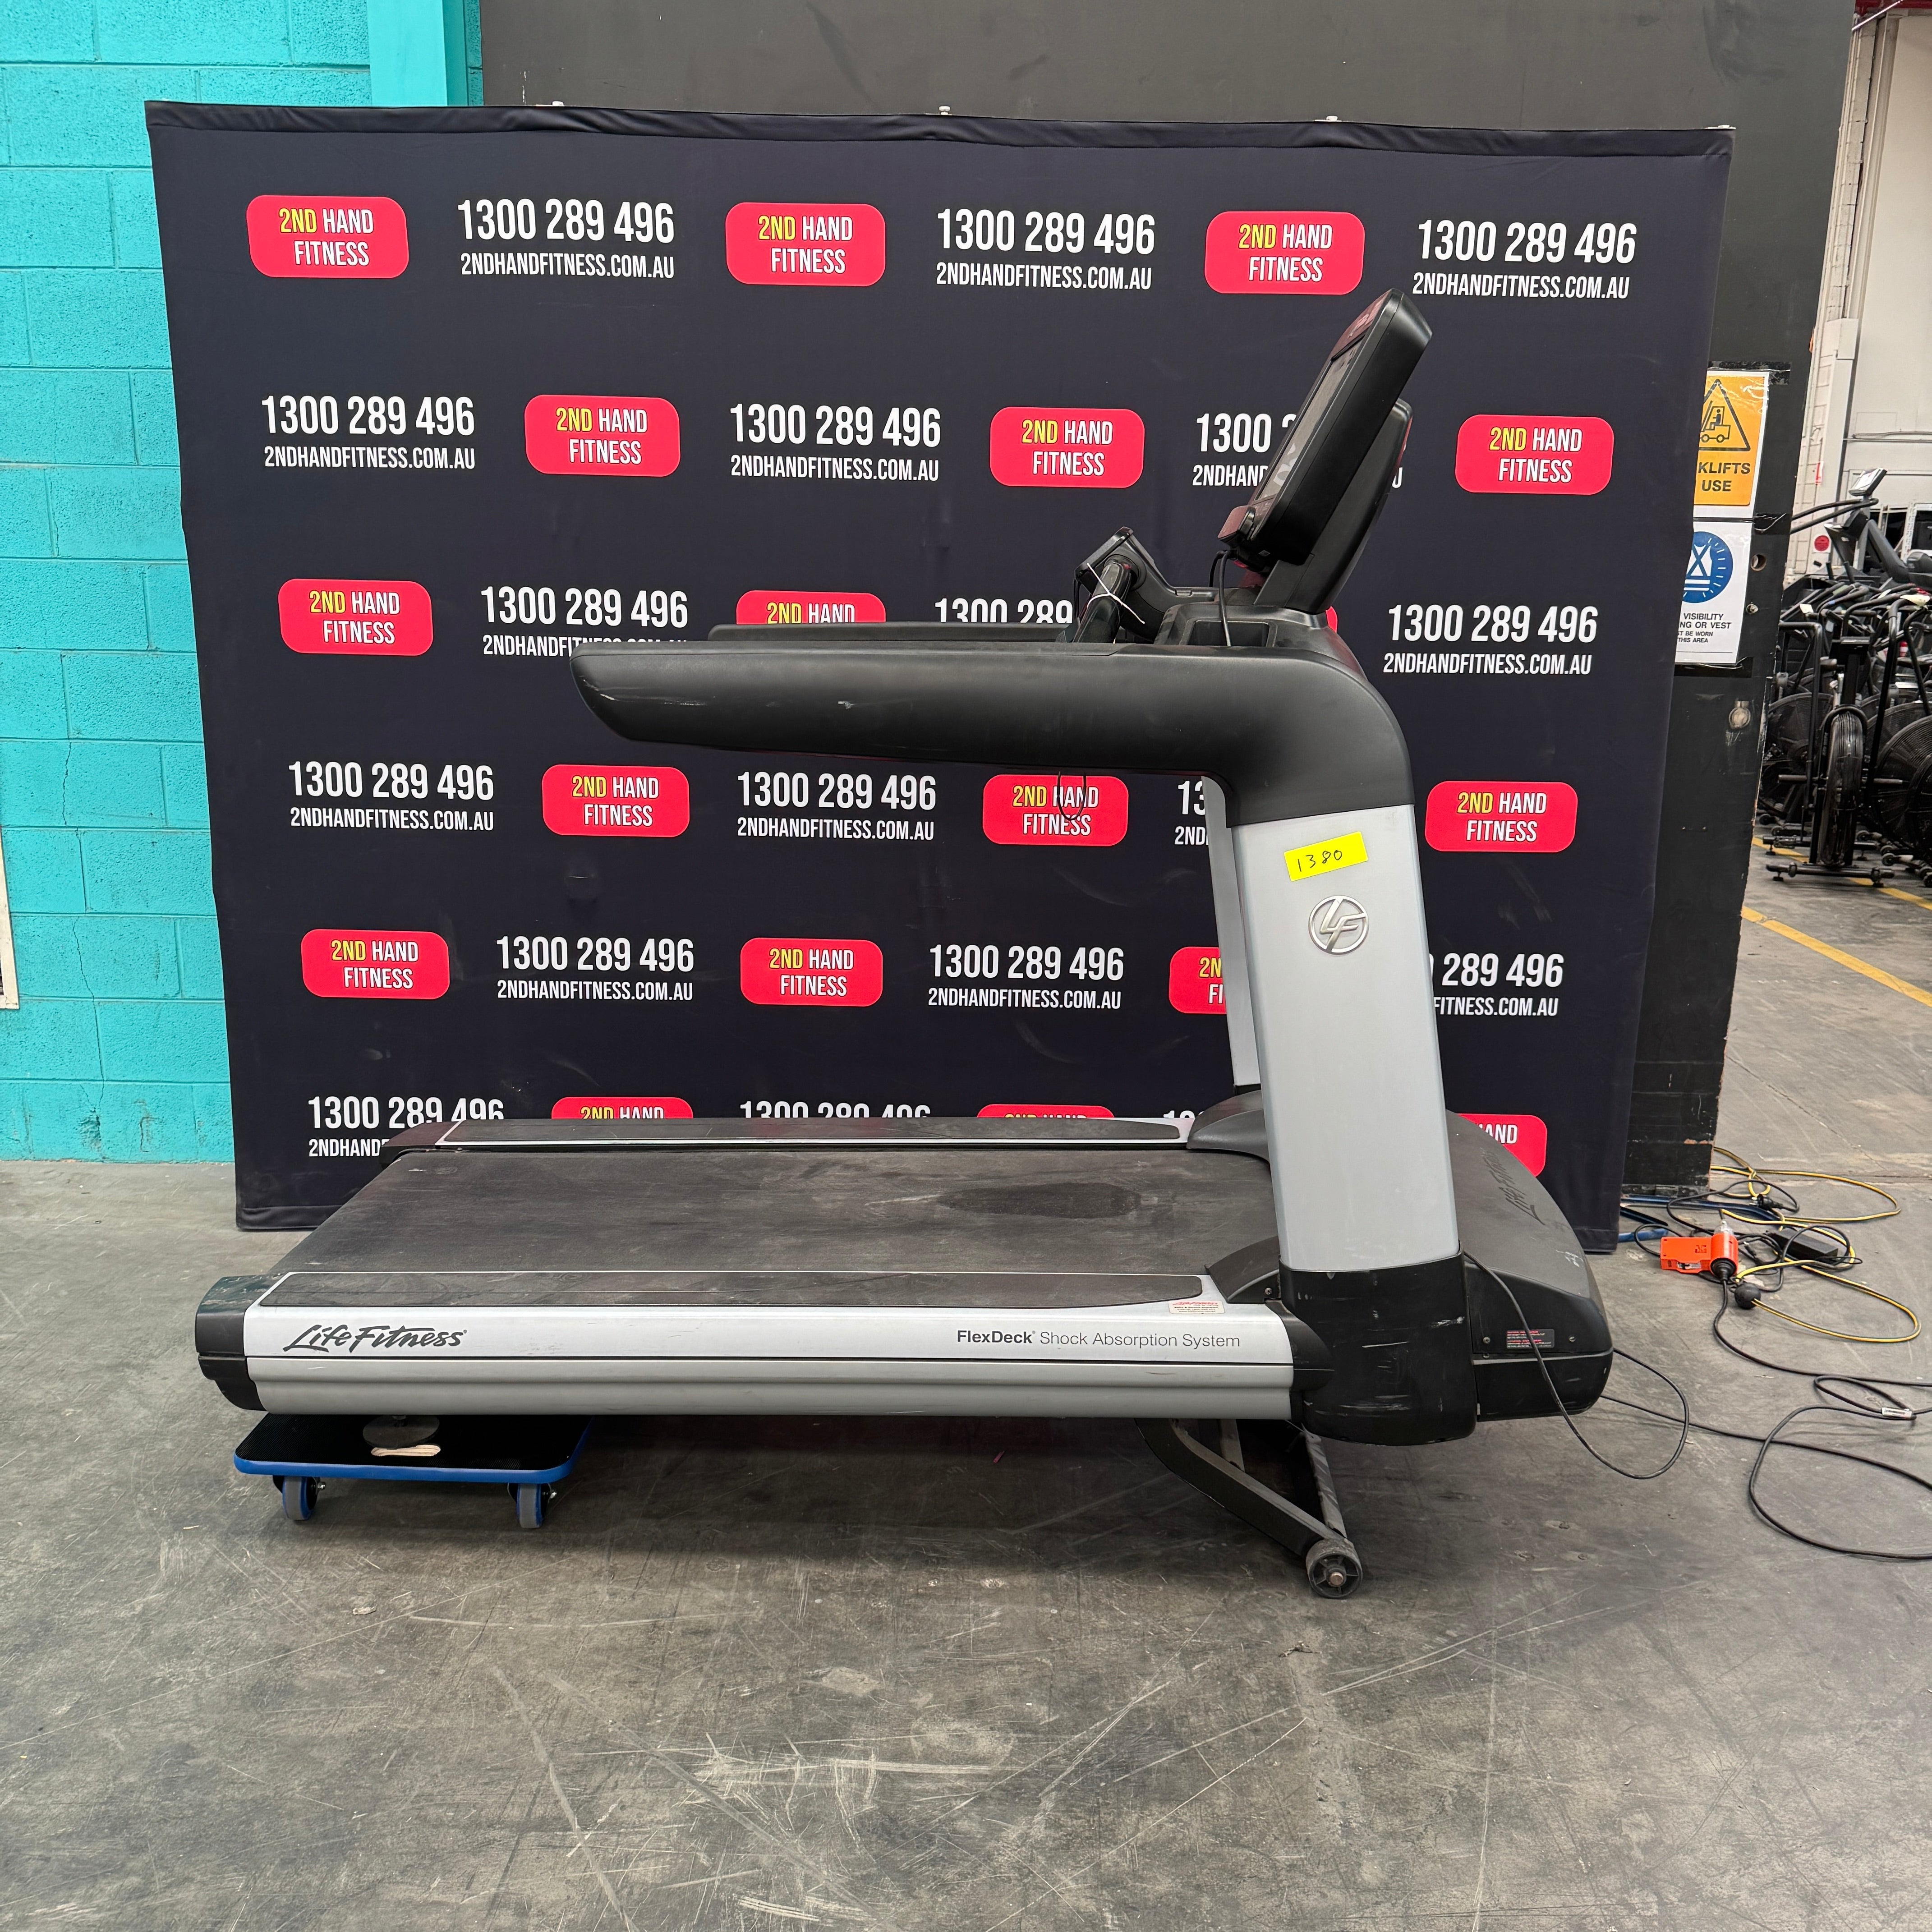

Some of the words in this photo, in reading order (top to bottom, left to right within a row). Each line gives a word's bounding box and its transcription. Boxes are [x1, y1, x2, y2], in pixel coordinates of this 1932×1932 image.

[279, 207, 317, 233] 2ND
[322, 208, 374, 234] HAND
[457, 198, 537, 240] 1300
[545, 198, 605, 241] 289
[613, 201, 675, 244] 496
[758, 215, 796, 240] 2ND
[802, 216, 853, 241] HAND
[937, 208, 1015, 252] 1300
[1024, 211, 1085, 254] 289
[1093, 213, 1155, 255] 496
[1238, 223, 1277, 249] 2ND
[1282, 223, 1333, 249] HAND
[1418, 219, 1497, 262] 1300
[1504, 221, 1567, 263] 289
[1573, 222, 1638, 264] 496
[294, 240, 370, 267] FITNESS
[460, 252, 675, 279] 2NDHANDFITNESS.COM.AU
[771, 247, 846, 274] FITNESS
[936, 261, 1152, 290] 2NDHANDFITNESS.COM.AU
[1248, 256, 1324, 282] FITNESS
[1412, 271, 1630, 299] 2NDHANDFITNESS.COM.AU
[261, 395, 339, 435] 1300
[347, 395, 407, 435] 289
[415, 396, 475, 436] 496
[556, 407, 593, 432] 2ND
[598, 408, 648, 433] HAND
[730, 403, 806, 445] 1300
[815, 405, 874, 446] 289
[882, 407, 941, 448] 496
[1021, 419, 1058, 444] 2ND
[1064, 420, 1113, 445] HAND
[1196, 412, 1272, 453] 1300
[1489, 426, 1527, 451] 2ND
[1532, 428, 1582, 452] HAND
[264, 445, 476, 470] 2NDHANDFITNESS.COM.AU
[569, 438, 642, 465] FITNESS
[1033, 451, 1105, 476] FITNESS
[730, 454, 939, 482] 2NDHANDFITNESS.COM.AU
[1498, 458, 1573, 483] FITNESS
[1697, 461, 1751, 474] KLIFTS
[1701, 479, 1732, 492] USE
[309, 590, 346, 614] 2ND
[351, 591, 400, 615] HAND
[480, 585, 557, 625] 1300
[565, 587, 622, 627] 289
[630, 589, 688, 629] 496
[766, 603, 802, 624] 2ND
[807, 603, 856, 624] HAND
[323, 620, 396, 644] FITNESS
[1388, 603, 1464, 642] 1300
[1471, 604, 1531, 643] 289
[1537, 605, 1599, 644] 496
[1383, 652, 1592, 675] 2NDHANDFITNESS.COM.AU
[288, 760, 363, 798] 1300
[371, 762, 428, 799] 289
[437, 764, 494, 801] 496
[572, 775, 607, 798] 2ND
[612, 776, 659, 799] HAND
[737, 771, 809, 808] 1300
[818, 773, 873, 810] 289
[880, 774, 936, 811] 496
[1012, 785, 1047, 807] 2ND
[1053, 786, 1099, 808] HAND
[1457, 791, 1494, 814] 2ND
[1498, 792, 1547, 814] HAND
[290, 806, 494, 831] 2NDHANDFITNESS.COM.AU
[584, 803, 653, 827] FITNESS
[1023, 813, 1091, 836] FITNESS
[737, 816, 934, 841] 2NDHANDFITNESS.COM.AU
[1466, 819, 1538, 842] FITNESS
[1297, 850, 1343, 872] 1380
[331, 939, 366, 961] 2ND
[371, 940, 419, 962] HAND
[496, 935, 568, 971] 1300
[576, 937, 631, 971] 289
[639, 938, 694, 972] 496
[769, 948, 803, 969] 2ND
[809, 948, 854, 970] HAND
[929, 944, 999, 979] 1300
[1007, 945, 1062, 980] 289
[1069, 947, 1124, 981] 496
[344, 966, 414, 989] FITNESS
[1198, 957, 1222, 978] 2N
[1441, 952, 1499, 987] 289
[1505, 953, 1564, 988] 496
[497, 979, 693, 1001] 2NDHANDFITNESS.COM.AU
[780, 974, 847, 997] FITNESS
[928, 987, 1122, 1010] 2NDHANDFITNESS.COM.AU
[1433, 996, 1559, 1017] FITNESS.COM.AU
[308, 1095, 380, 1129] 1300
[387, 1096, 443, 1129] 289
[283, 1324, 352, 1352] Life
[1040, 1331, 1088, 1345] Shock
[1092, 1333, 1178, 1349] Absorption
[1182, 1334, 1240, 1350] System
